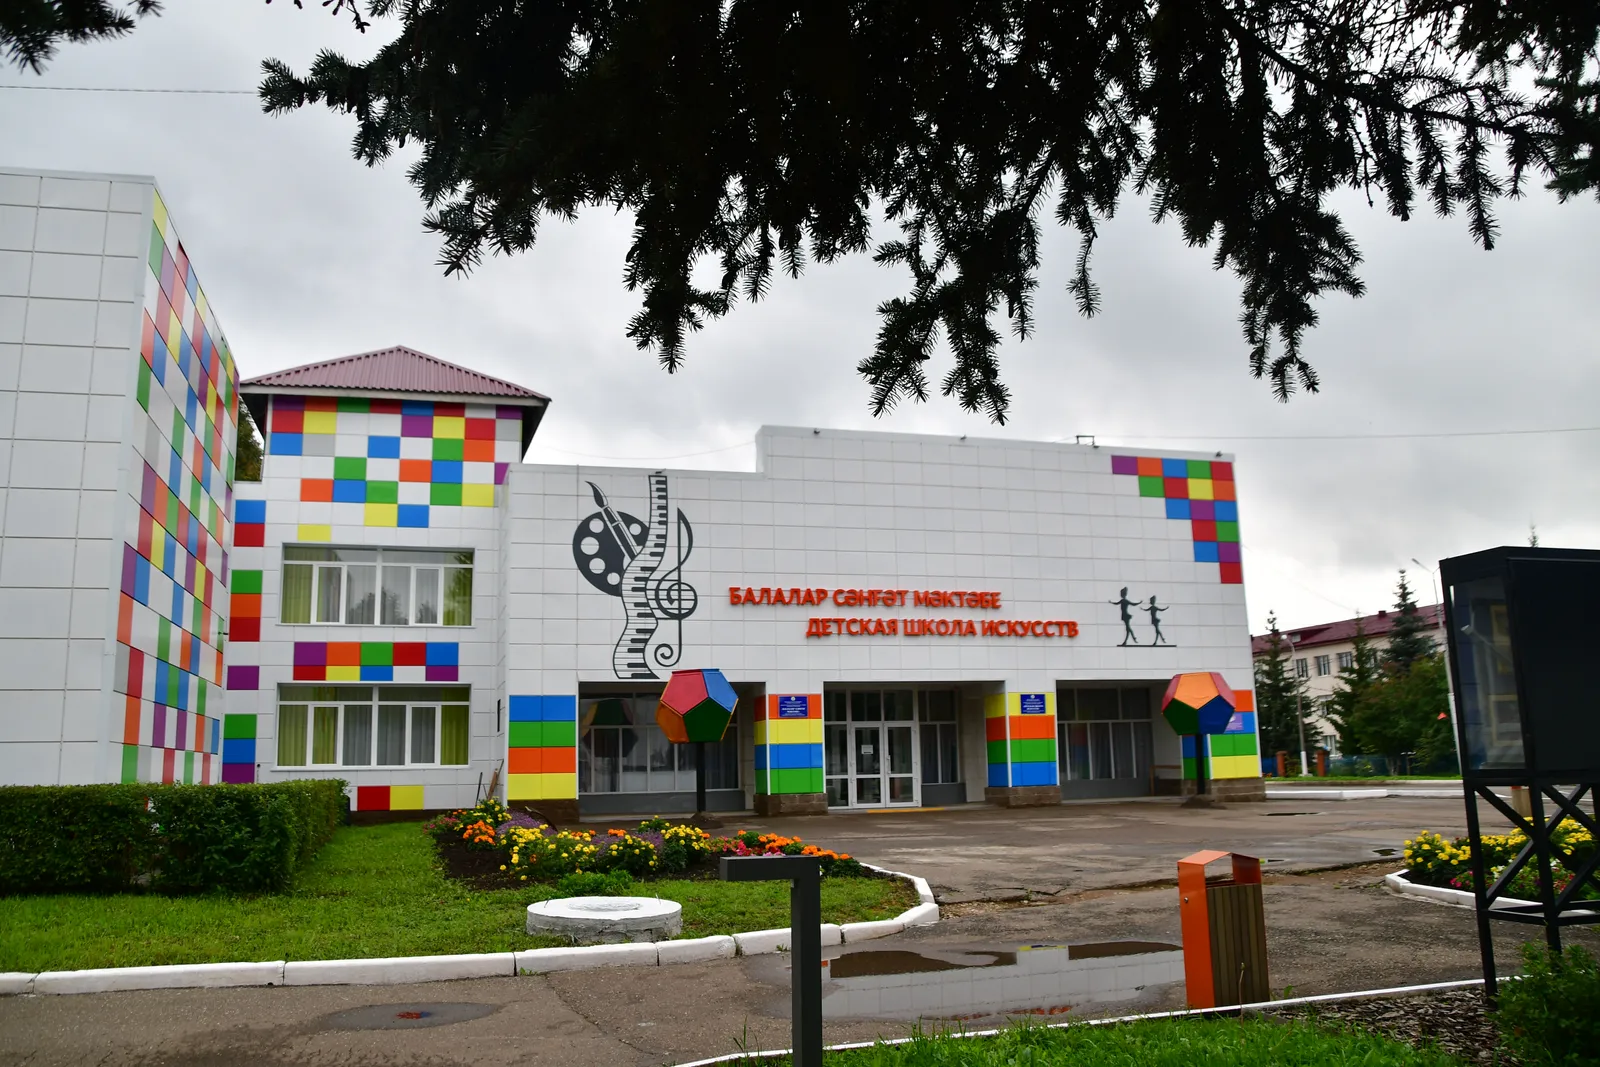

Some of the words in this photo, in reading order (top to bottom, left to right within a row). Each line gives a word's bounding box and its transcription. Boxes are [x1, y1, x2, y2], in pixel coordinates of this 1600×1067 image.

[729, 586, 829, 606] БАЛАЛАР
[913, 590, 1001, 610] МӘКТӘБЕ
[806, 617, 899, 638] ДЕТСКАЯ
[903, 618, 978, 637] ШКОЛА
[981, 619, 1080, 638] ИСКУССТВ
